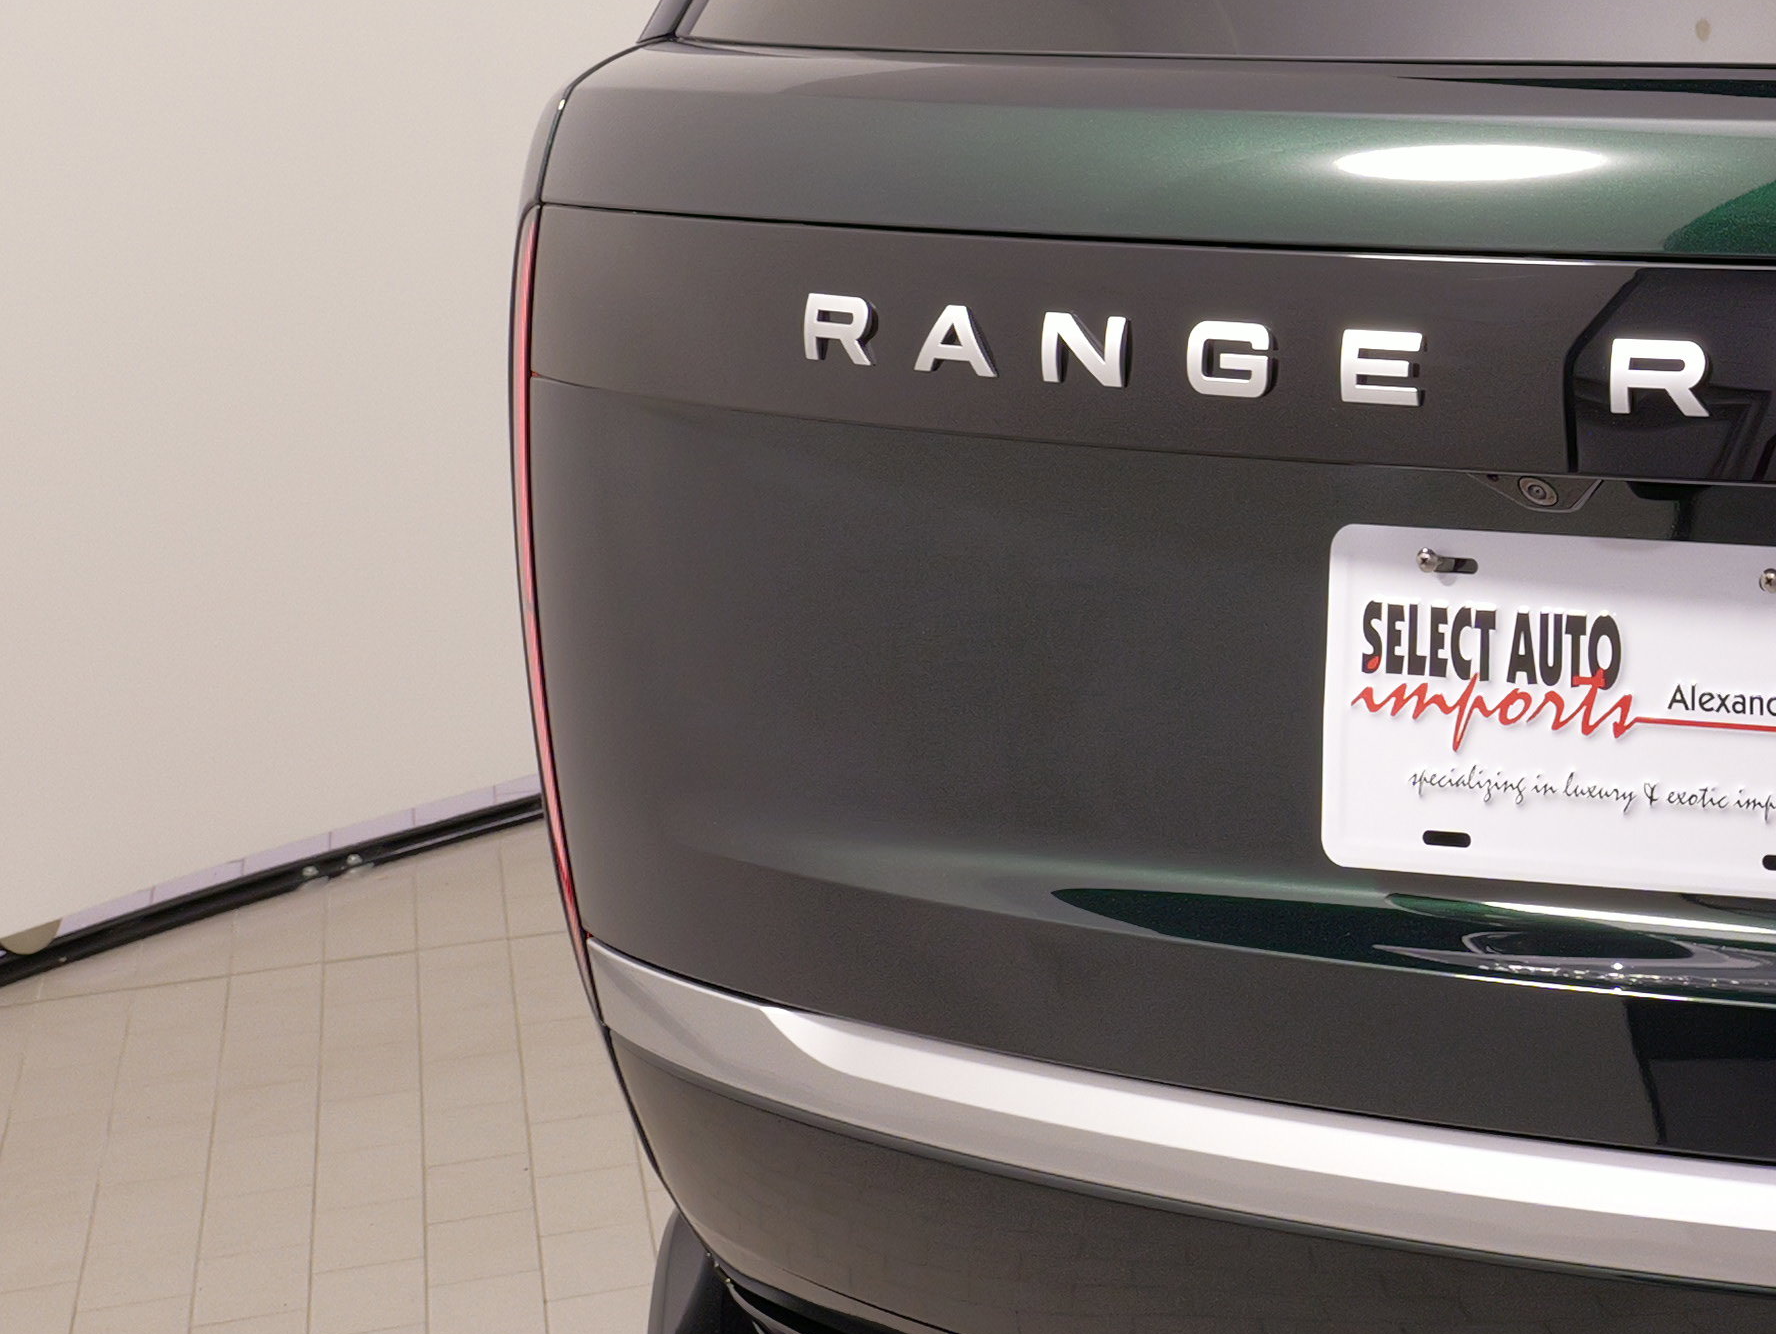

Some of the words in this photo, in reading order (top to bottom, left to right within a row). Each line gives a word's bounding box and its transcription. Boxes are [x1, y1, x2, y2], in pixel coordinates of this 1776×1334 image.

[804, 291, 1426, 407] RANGE
[1361, 600, 1496, 681] SELECT
[1506, 612, 1622, 690] AUTO
[1350, 667, 1634, 752] imports
[1408, 765, 1526, 805] specializing
[1531, 775, 1557, 796] in
[1562, 772, 1637, 813] luxury
[1667, 787, 1730, 809] exotic
